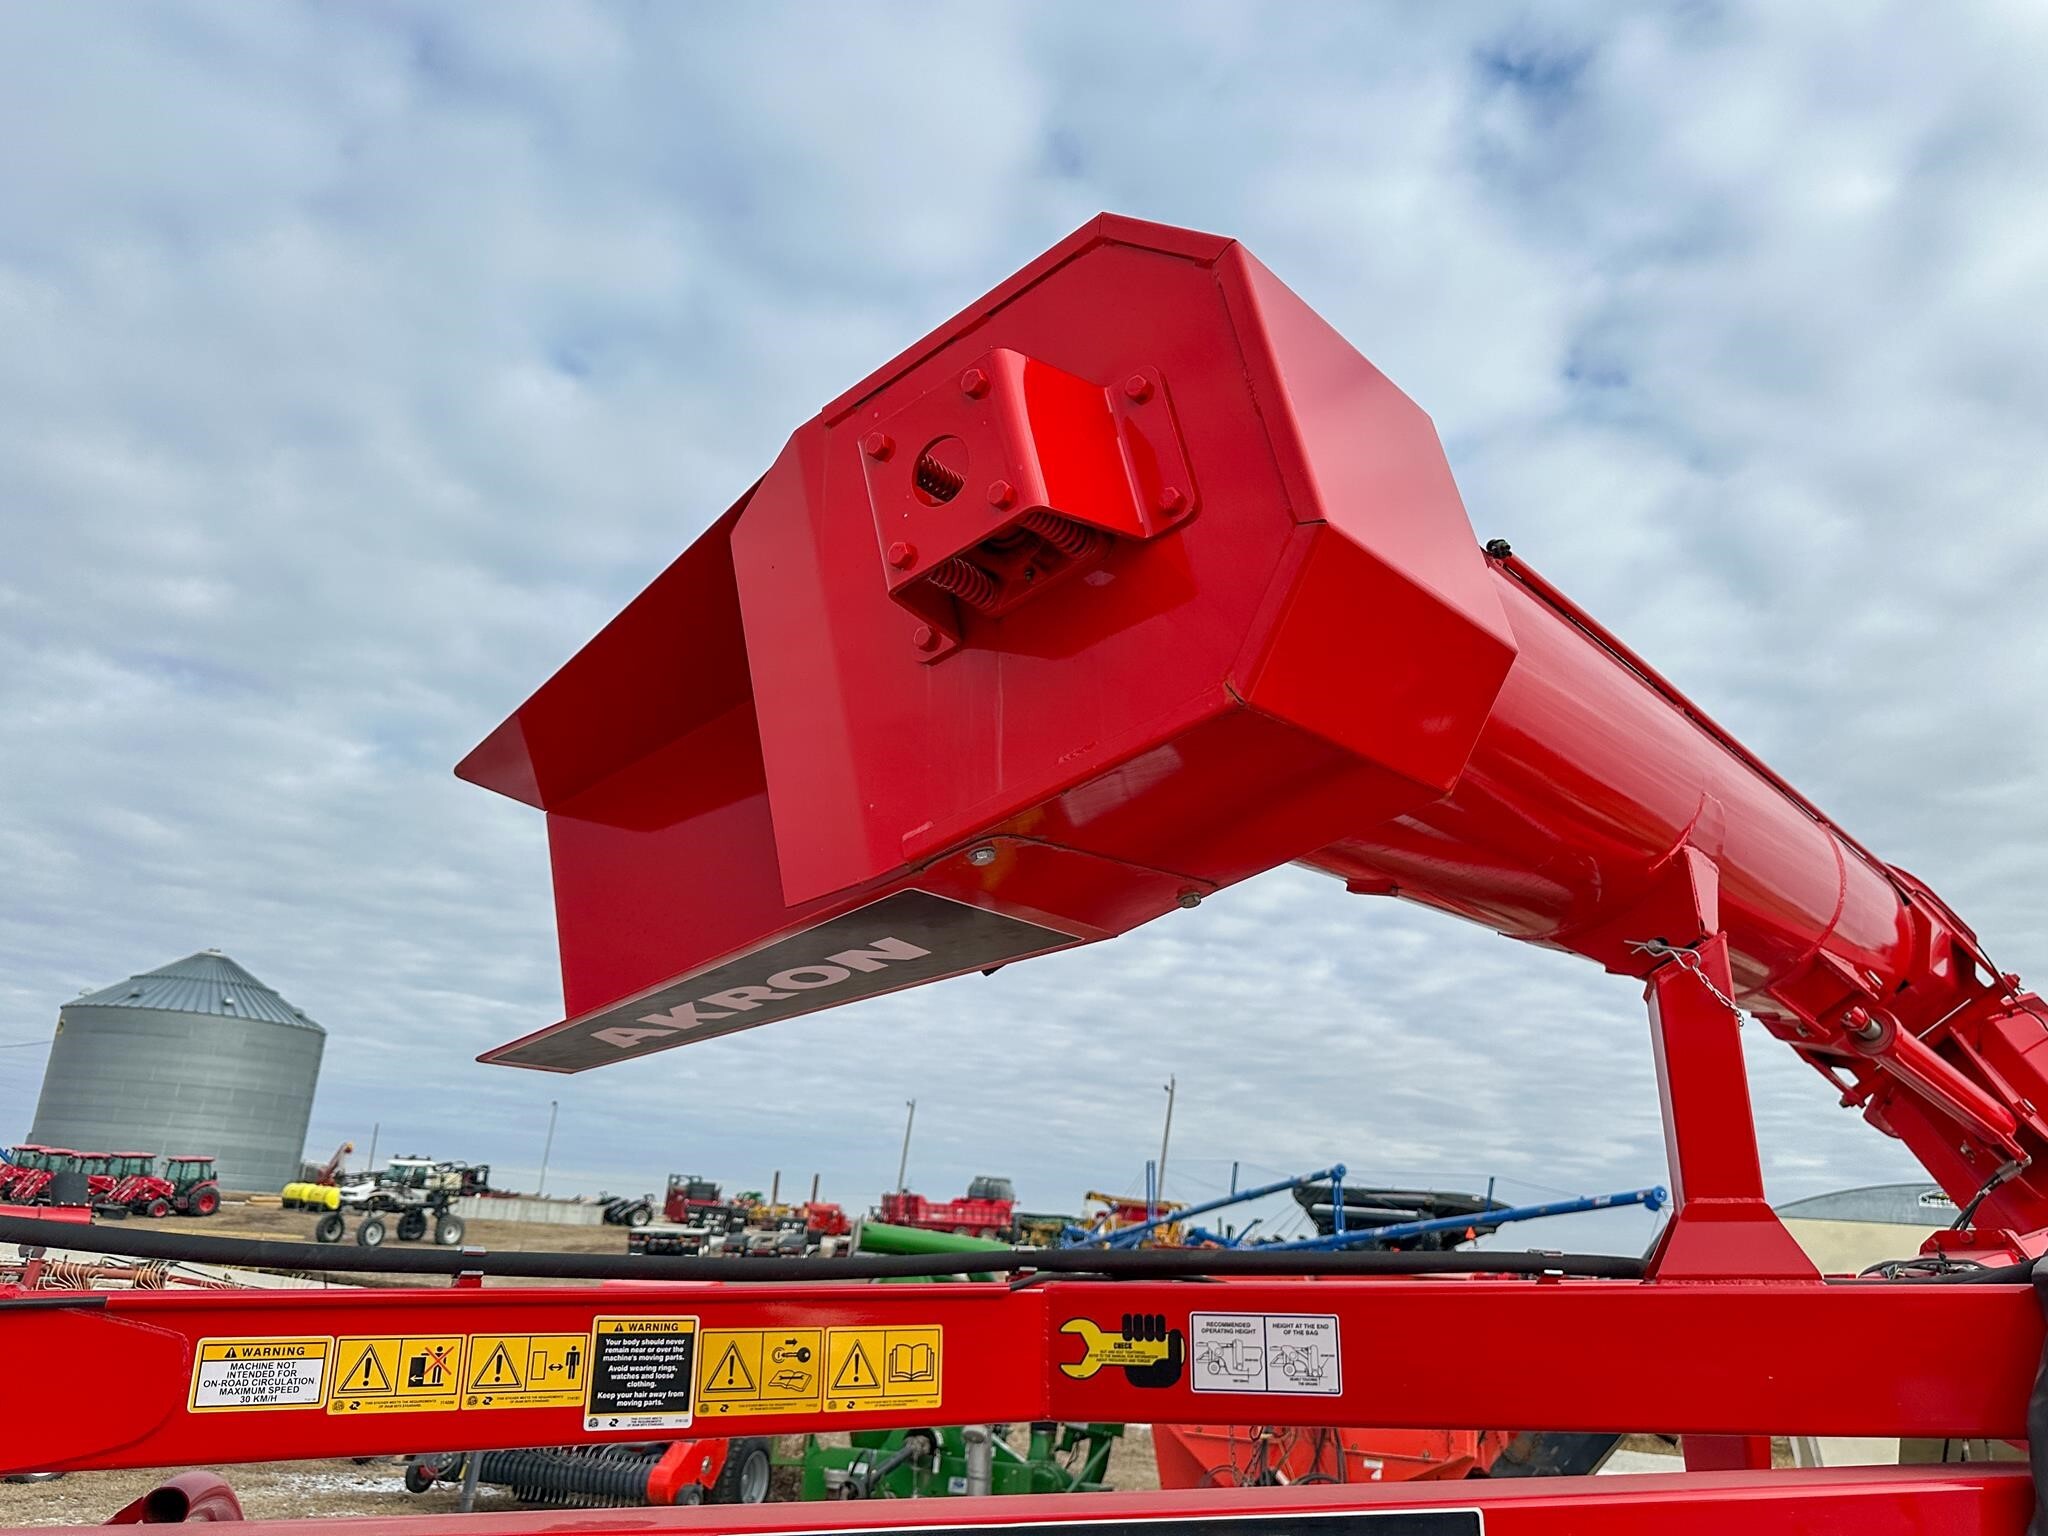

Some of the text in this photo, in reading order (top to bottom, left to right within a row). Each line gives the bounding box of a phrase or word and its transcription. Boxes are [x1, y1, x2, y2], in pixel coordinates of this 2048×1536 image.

[590, 936, 932, 1049] AKRON
[628, 1323, 679, 1332] WARNING
[623, 1339, 641, 1347] body
[242, 1347, 305, 1357] WARNING
[638, 1354, 664, 1362] moving
[665, 1354, 685, 1362] parts.
[230, 1362, 297, 1371] MACHINE NOT
[629, 1365, 657, 1373] wearing
[658, 1365, 678, 1373] rings,
[227, 1370, 297, 1379] INTENDED FOR
[203, 1379, 249, 1388] ON-ROAD
[627, 1381, 657, 1389] clothing.
[219, 1385, 300, 1395] MAXIMUM SPEED
[597, 1391, 616, 1400] Keep
[616, 1392, 633, 1400] your
[648, 1391, 667, 1399] away
[616, 1399, 664, 1408] moving parts.
